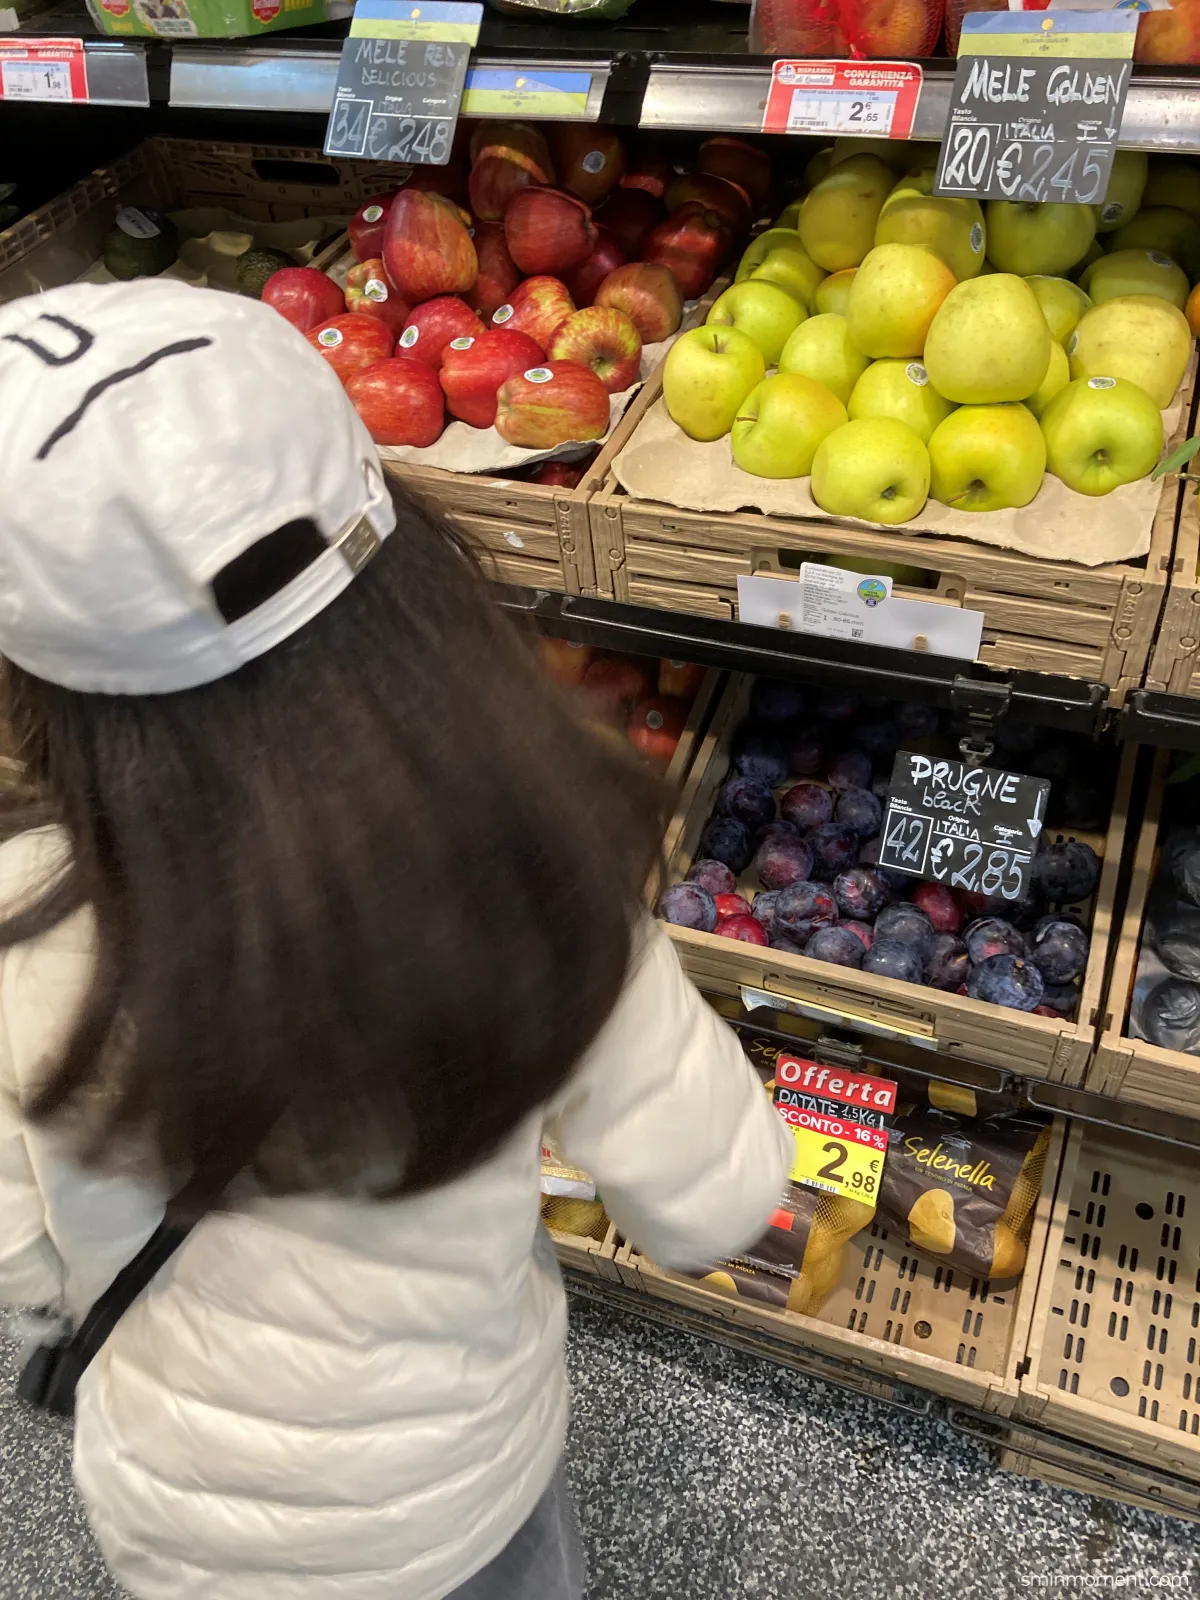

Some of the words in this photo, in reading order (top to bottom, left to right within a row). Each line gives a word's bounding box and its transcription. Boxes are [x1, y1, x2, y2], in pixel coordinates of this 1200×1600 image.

[355, 40, 409, 65] MELE
[424, 43, 456, 67] RED
[361, 67, 437, 87] DELICIOUS
[844, 69, 913, 81] CONVENIENZA
[849, 78, 904, 88] GARANTITA
[961, 59, 1037, 104] MELE
[1046, 63, 1127, 106] GOLDEN
[953, 107, 972, 115] Tasto
[331, 102, 366, 151] 34
[368, 117, 389, 159] €
[388, 118, 449, 164] 2,48
[1005, 122, 1055, 140] ITALIA
[945, 126, 990, 185] 20
[996, 142, 1023, 196] €
[1019, 145, 1108, 203] 2,45
[910, 755, 1020, 804] PRUGNE
[889, 803, 913, 812] Bilancia
[890, 796, 908, 805] Tasto
[936, 819, 980, 840] ITALIA
[948, 815, 970, 825] Origine
[993, 825, 1023, 836] Categoria
[886, 817, 924, 863] 42
[931, 837, 955, 880] €
[951, 843, 1032, 899] 2,85
[780, 1061, 893, 1107] Offerta
[779, 1089, 839, 1118] PATATE
[778, 1107, 843, 1135] SCONTO
[817, 1142, 876, 1193] 2,98
[869, 1159, 880, 1173] €
[903, 1136, 997, 1191] Selenella
